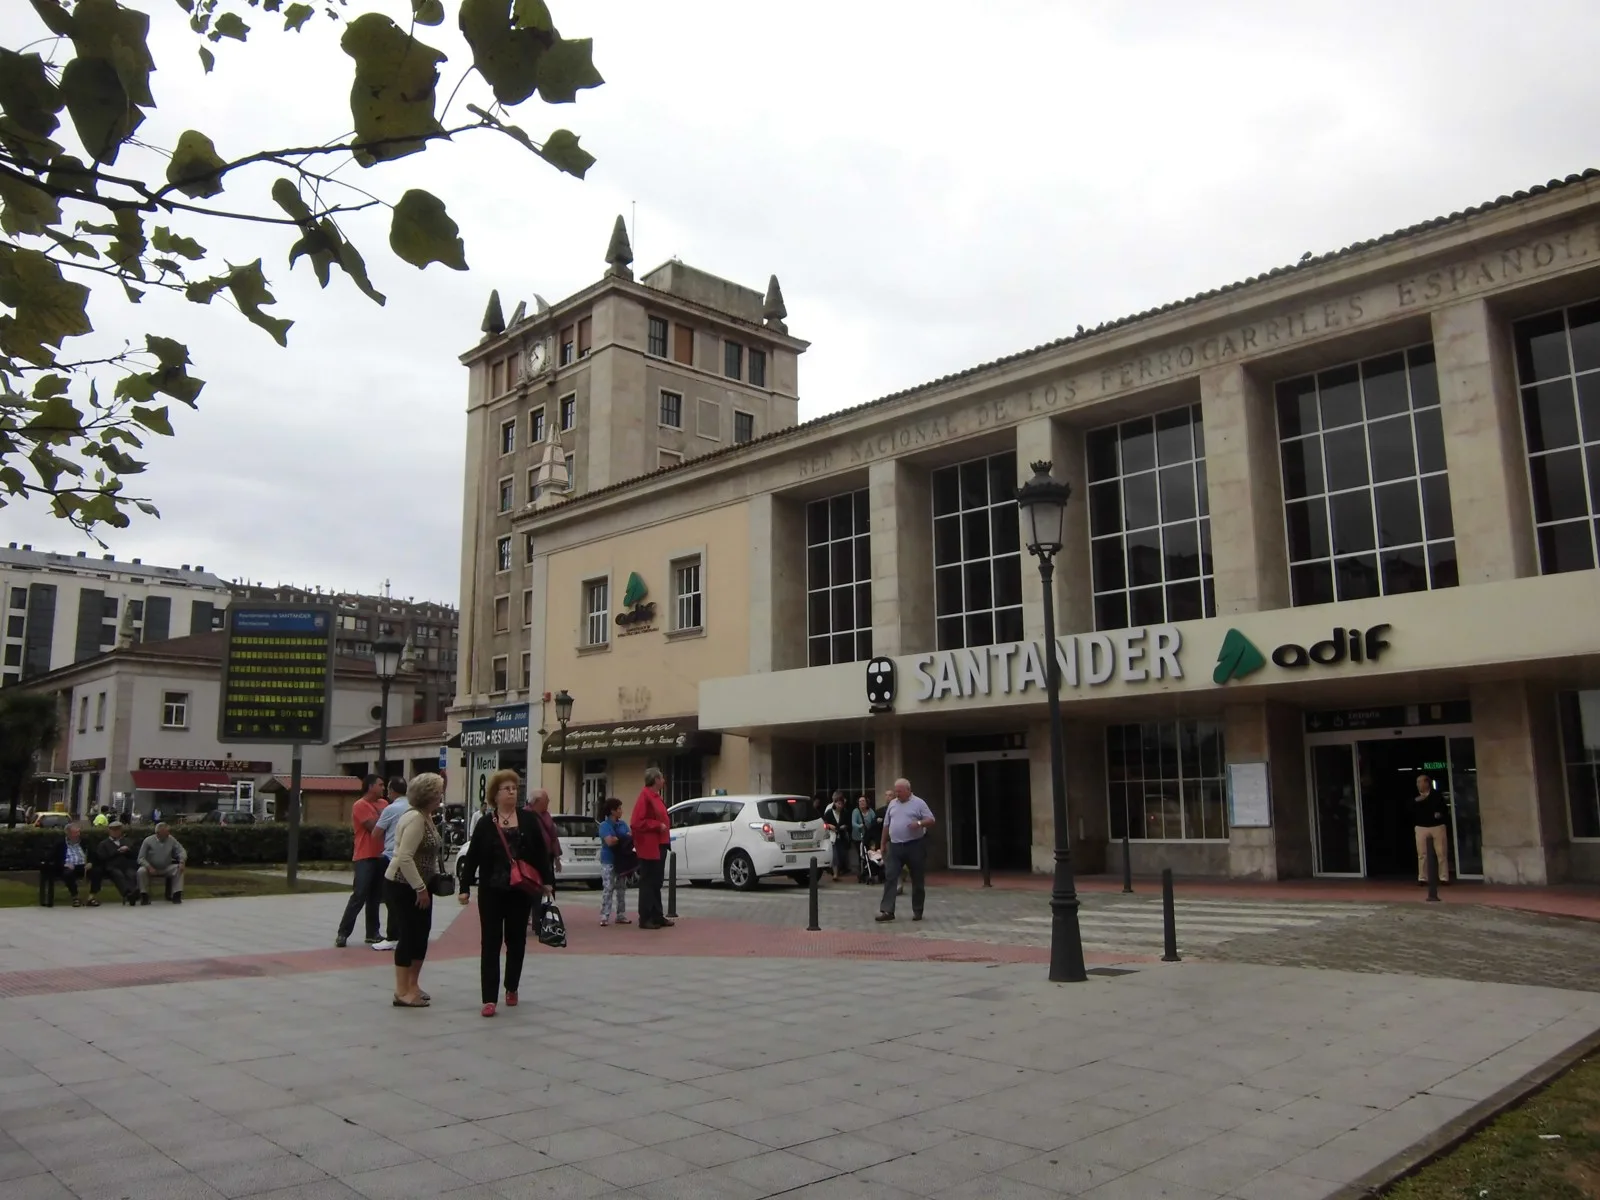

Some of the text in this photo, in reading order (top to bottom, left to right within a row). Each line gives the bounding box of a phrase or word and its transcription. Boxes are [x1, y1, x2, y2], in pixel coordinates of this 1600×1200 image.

[850, 414, 958, 463] NACIONAL
[978, 400, 1008, 427] DE
[1028, 380, 1078, 412] LOS
[1100, 296, 1364, 391] FERROCARRILES
[1272, 623, 1392, 668] adif
[913, 624, 1184, 701] SANTANDER
[460, 727, 529, 748] CAFETERIA RESTAURANTE
[642, 723, 675, 733] 2000
[143, 758, 216, 767] CAFETERIA
[476, 755, 497, 770] Menú
